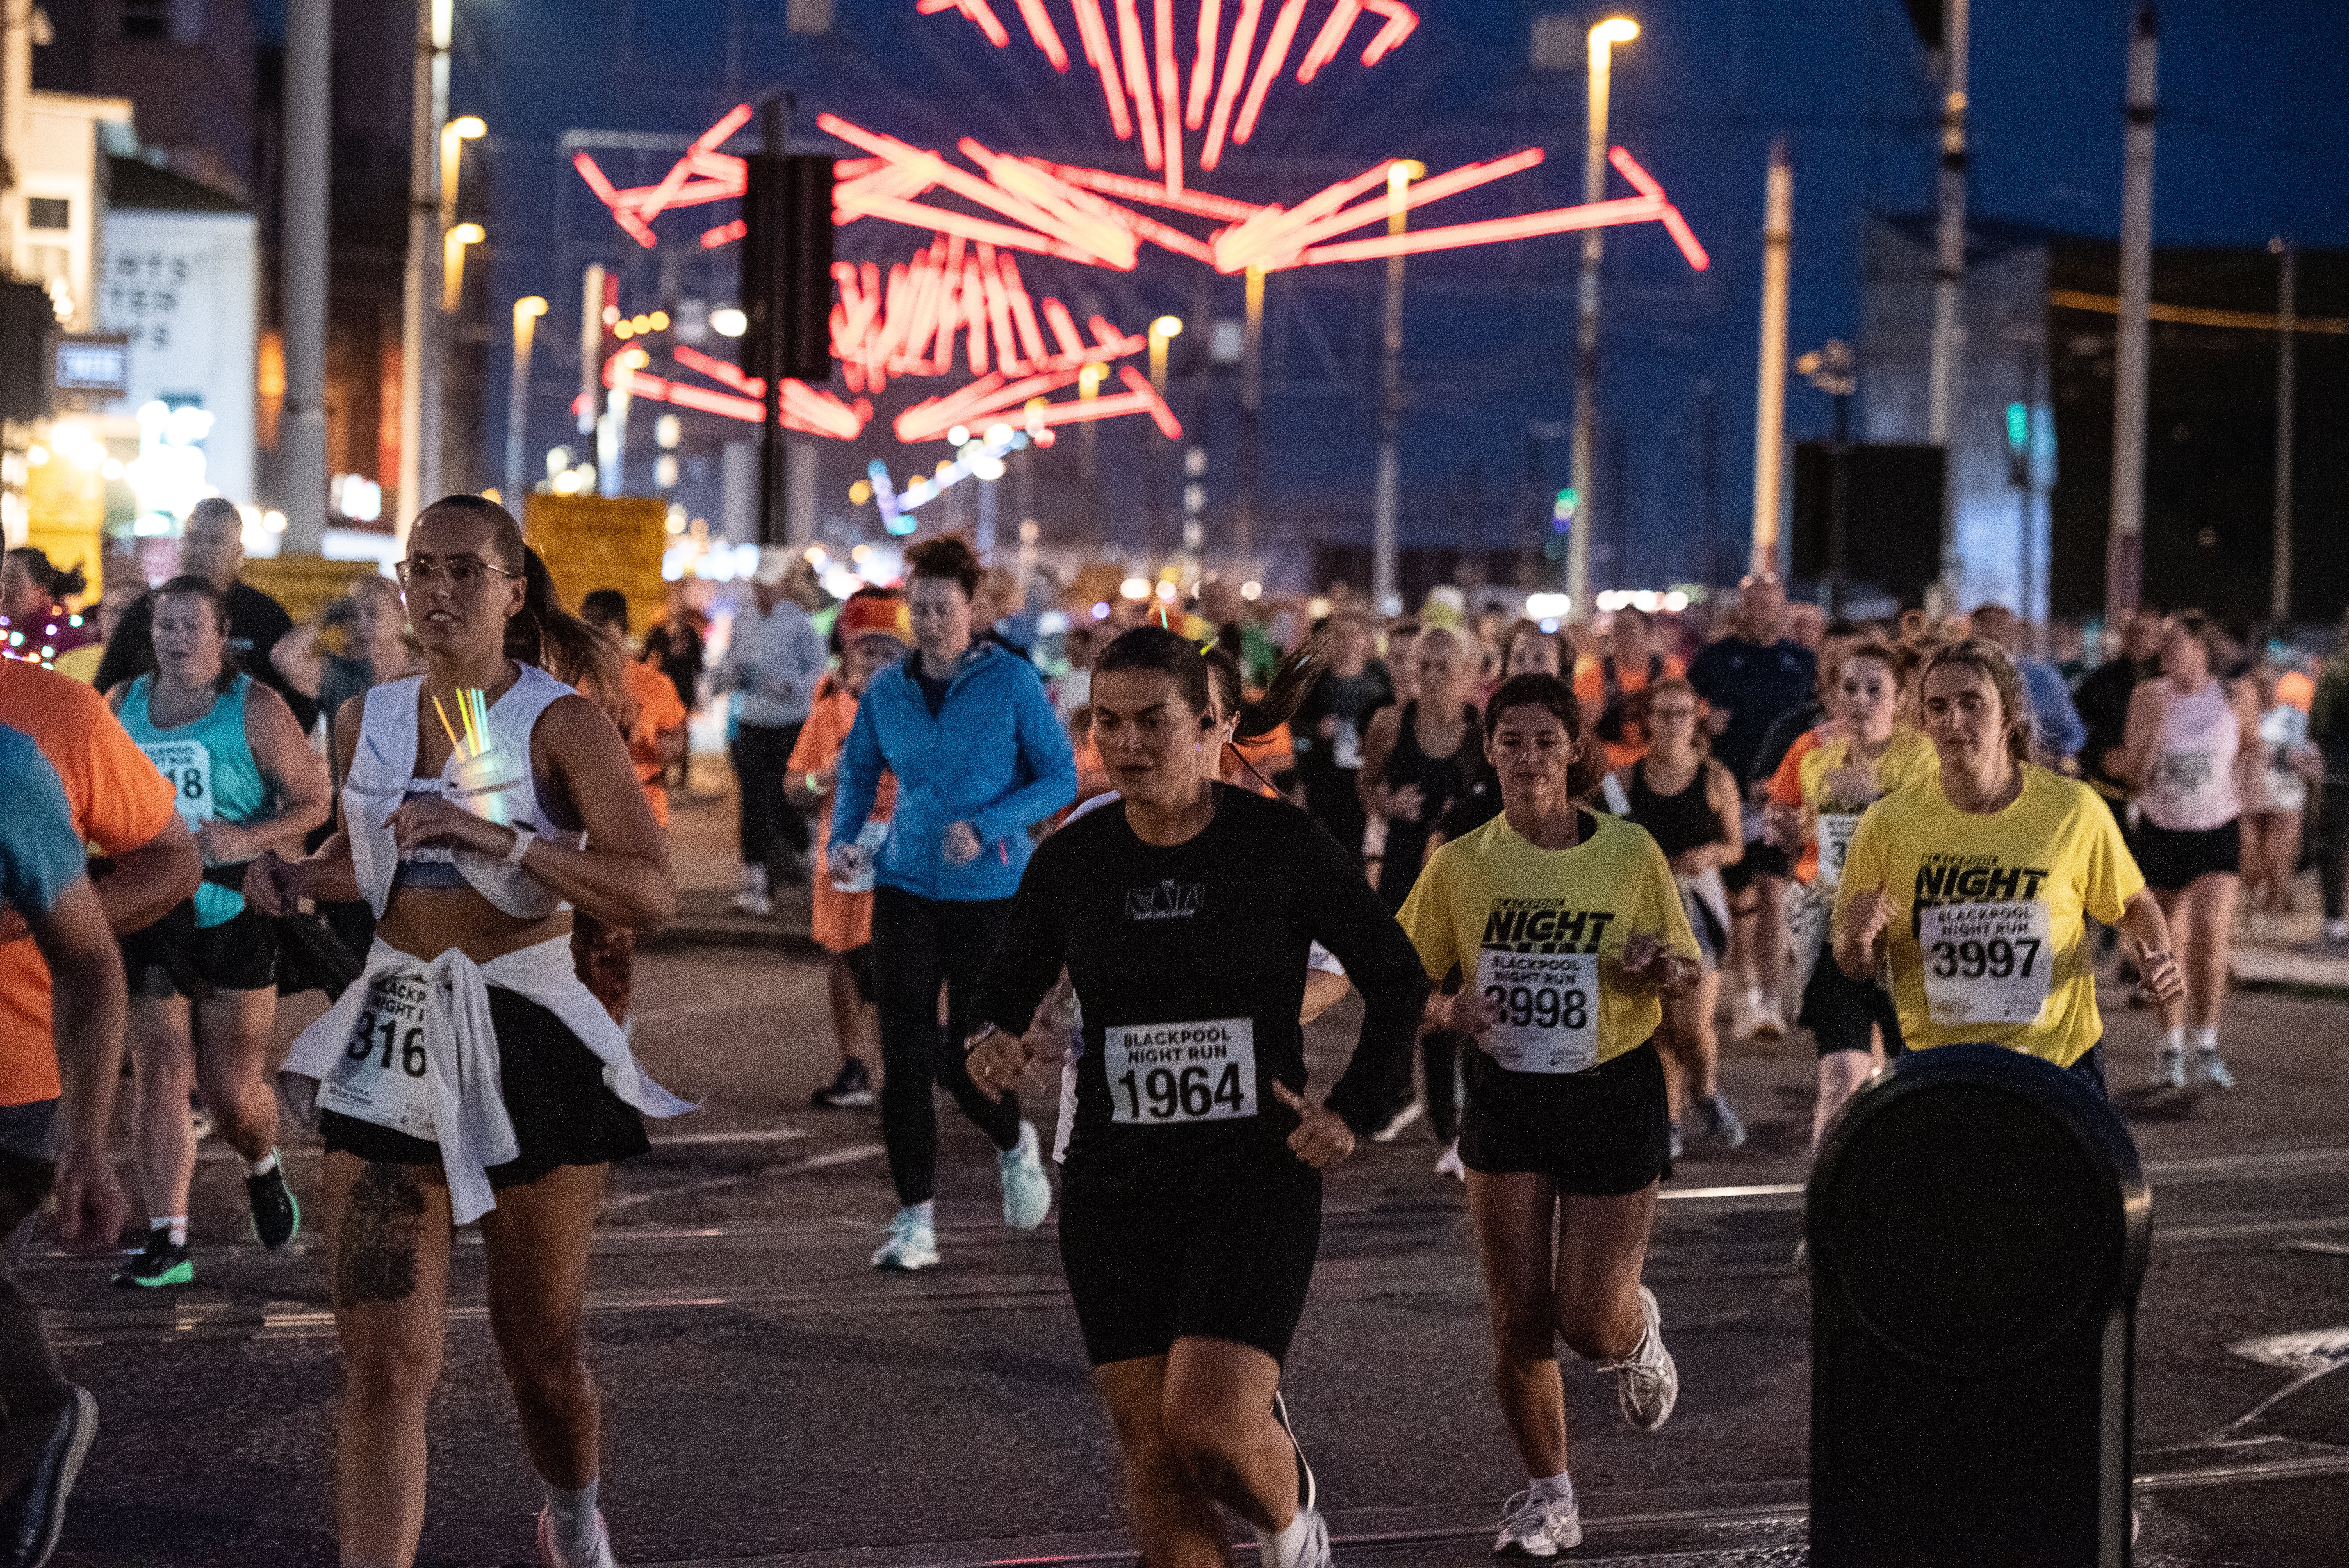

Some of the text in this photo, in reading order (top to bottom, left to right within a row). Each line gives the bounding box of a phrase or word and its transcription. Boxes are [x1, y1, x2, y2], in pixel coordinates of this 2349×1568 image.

[1915, 864, 2049, 899] NIGHT
[1937, 906, 2033, 923] BLACKPOOL
[1483, 911, 1615, 941] NIGHT
[1941, 919, 2028, 937] NIGHT RUN
[1492, 956, 1581, 971] BLACKPOOL
[1932, 937, 2041, 979] 3997
[1494, 971, 1576, 984] NIGHT RUN
[1124, 1027, 1231, 1048] BLACKPOOL
[1128, 1045, 1226, 1063] NIGHT RUN
[1119, 1061, 1244, 1119] 1964
